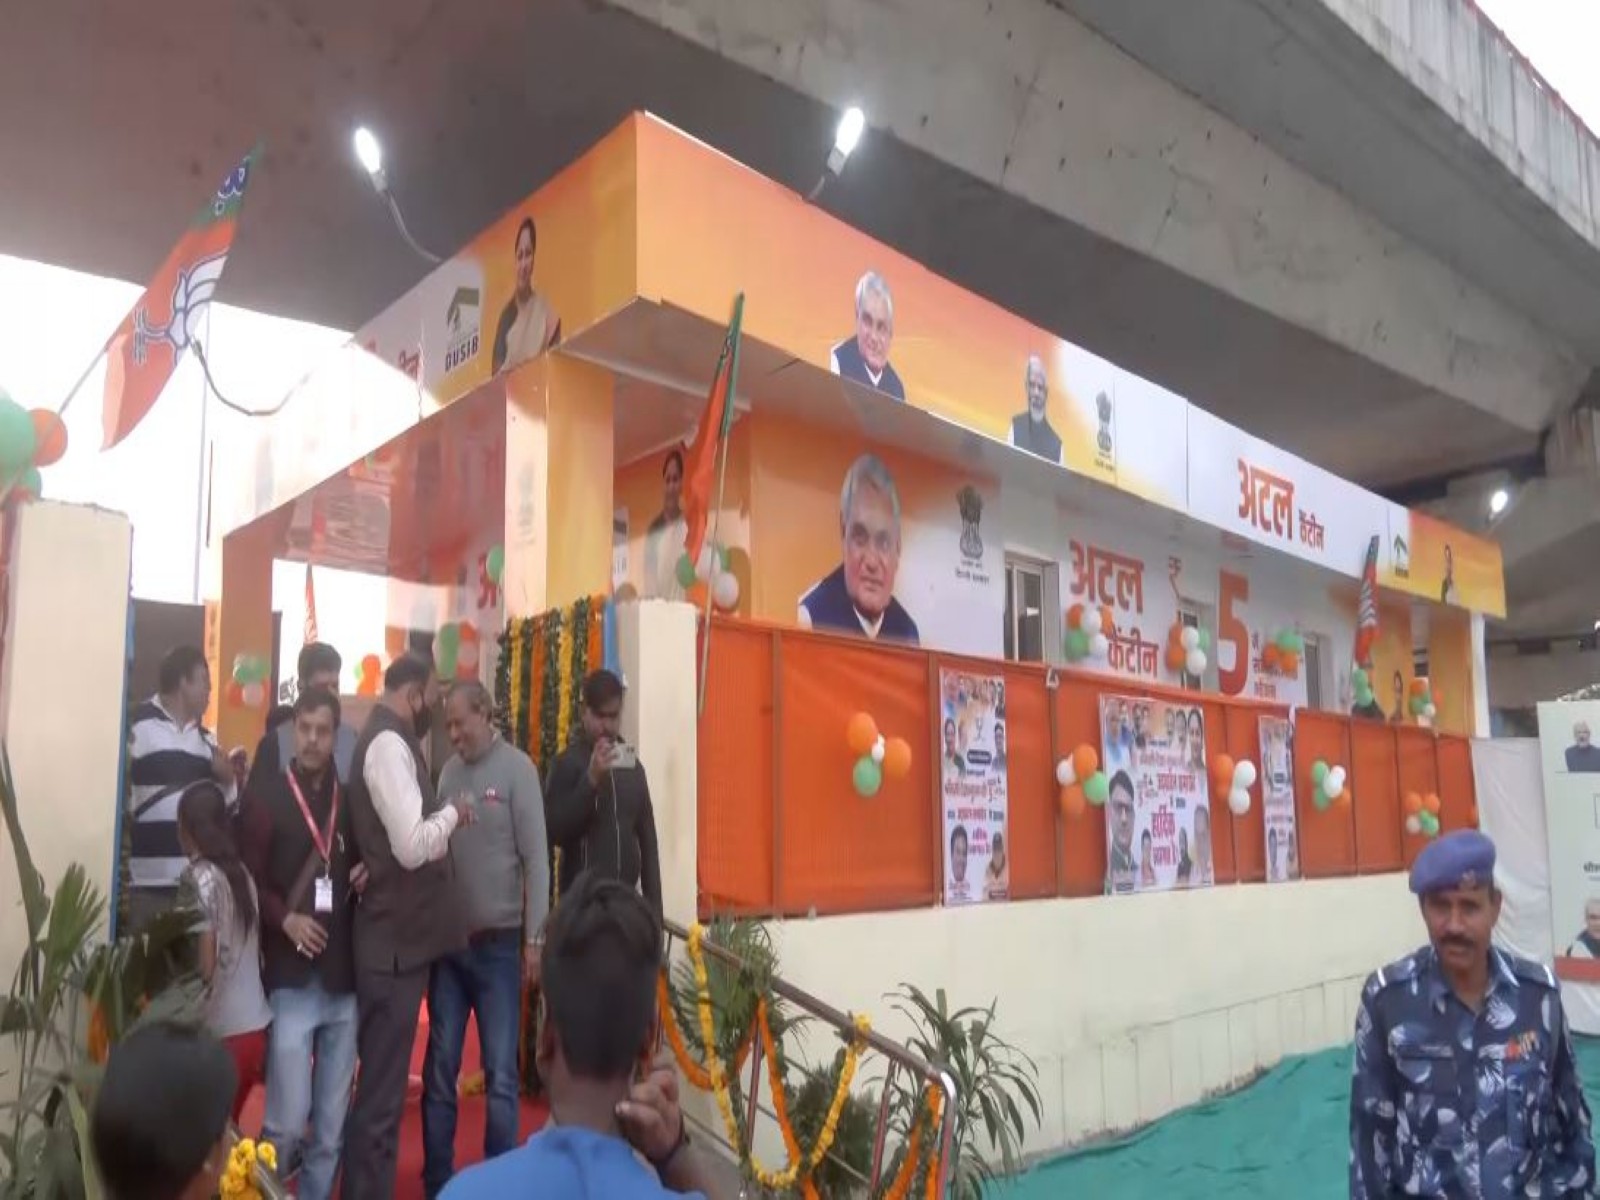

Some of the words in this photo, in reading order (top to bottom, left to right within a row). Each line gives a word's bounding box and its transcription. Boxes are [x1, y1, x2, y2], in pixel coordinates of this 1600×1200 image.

[444, 335, 479, 372] DUSIB
[1238, 458, 1293, 541] अटल
[1069, 539, 1143, 614] अटल
[1218, 568, 1249, 696] 5
